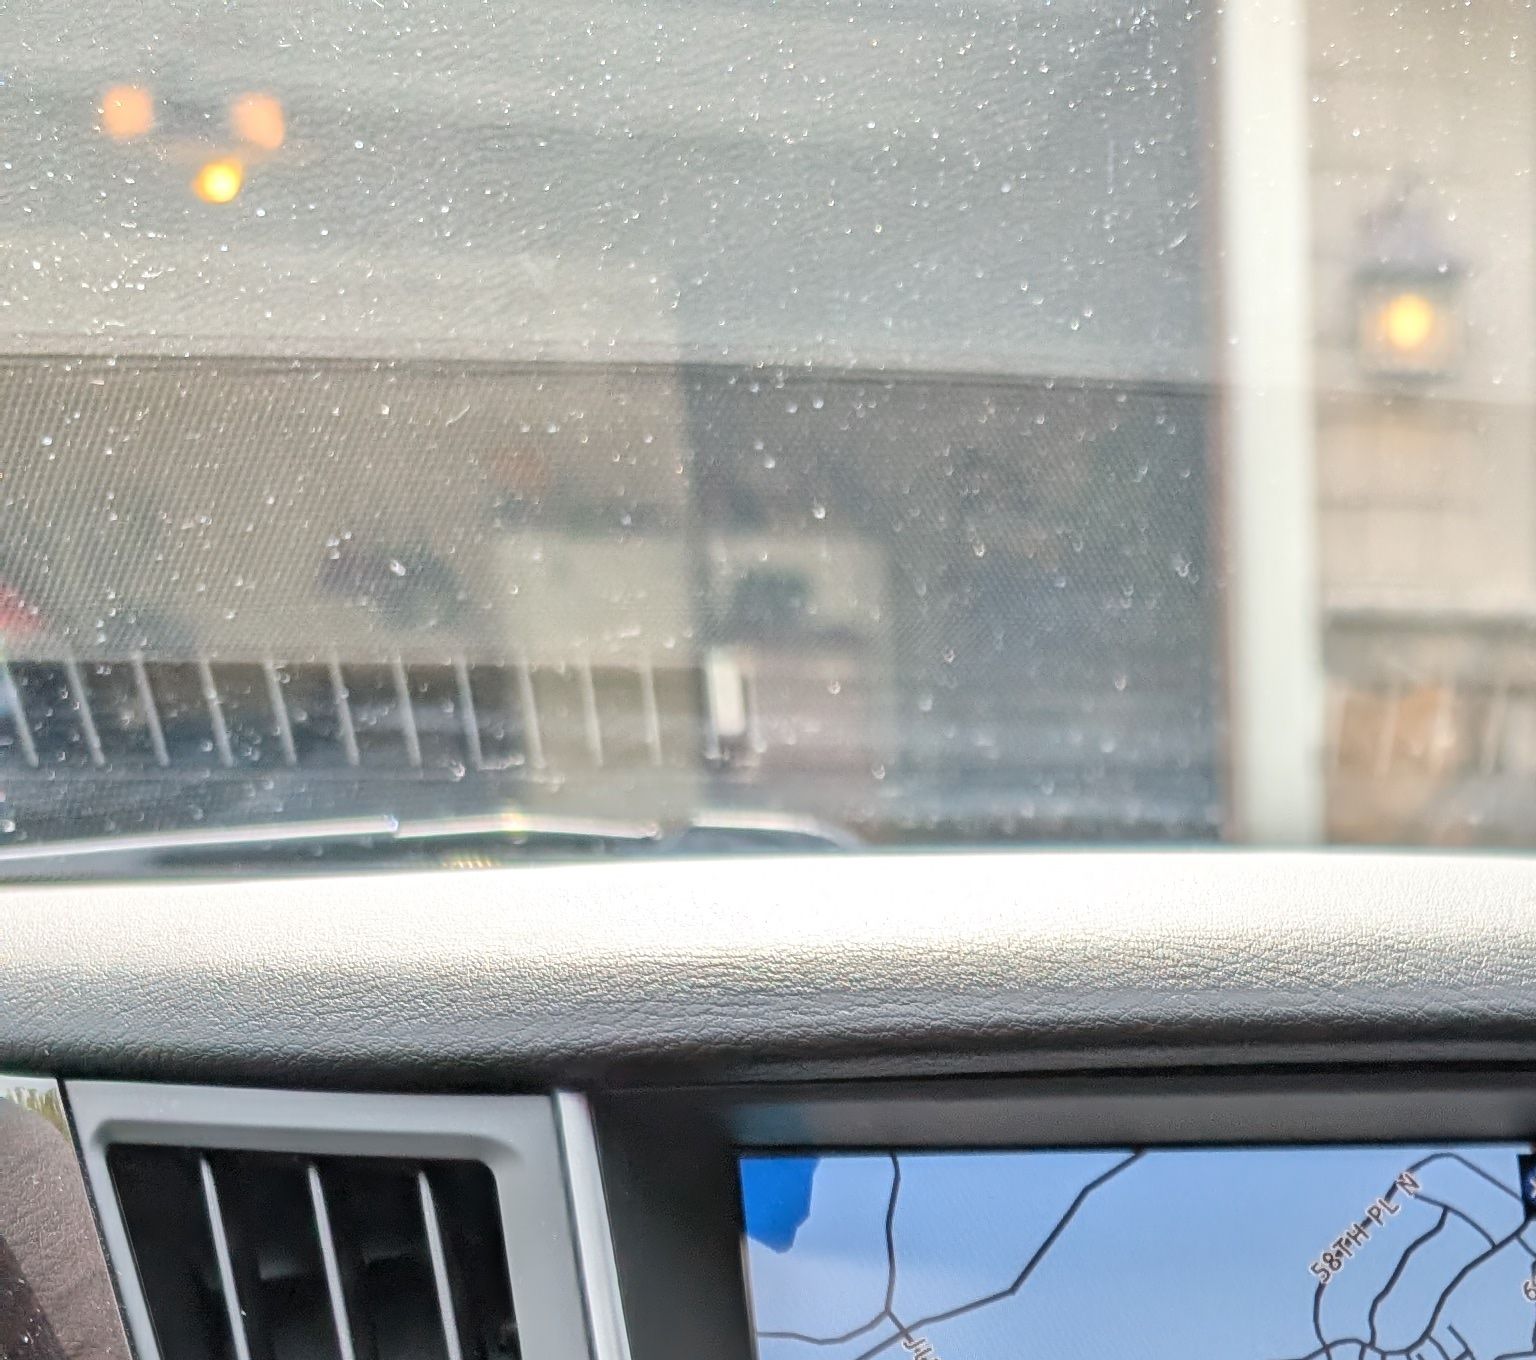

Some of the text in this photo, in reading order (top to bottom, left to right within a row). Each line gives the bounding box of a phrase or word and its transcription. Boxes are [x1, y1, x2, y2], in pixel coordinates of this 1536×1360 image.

[1310, 1173, 1420, 1283] 58TH PL N
